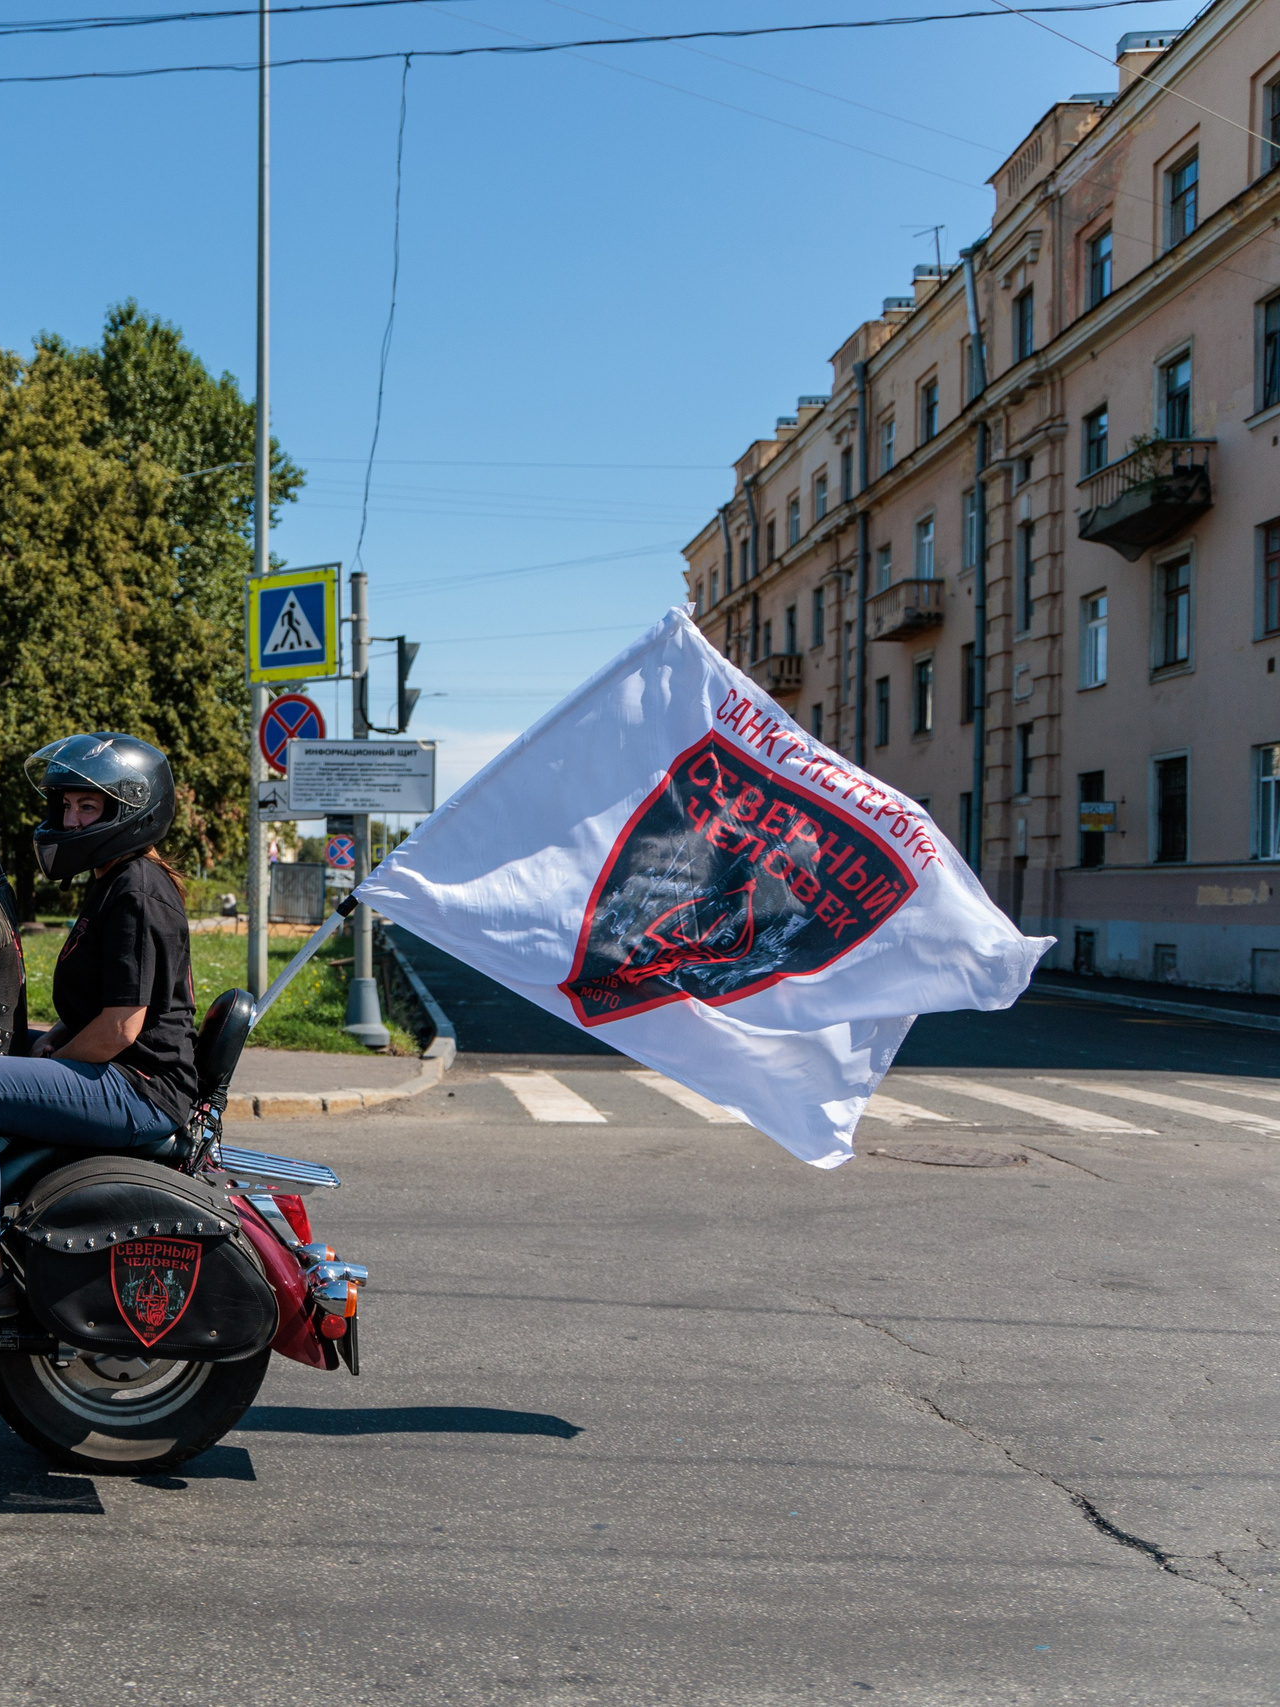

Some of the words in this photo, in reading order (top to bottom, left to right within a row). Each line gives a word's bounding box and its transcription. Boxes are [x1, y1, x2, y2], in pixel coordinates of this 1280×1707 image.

[305, 747, 395, 756] ИНФОРМАЦИОННЫЙ
[397, 749, 418, 757] ЩИТ
[687, 752, 901, 920] СЕВЕРНЫЙ
[686, 796, 858, 939] ЧЕЛОВЕК
[580, 986, 620, 1009] МОТО
[116, 1242, 196, 1260] СЕВЕРНЫЙ
[122, 1257, 190, 1272] ЧЕЛОВЕК
